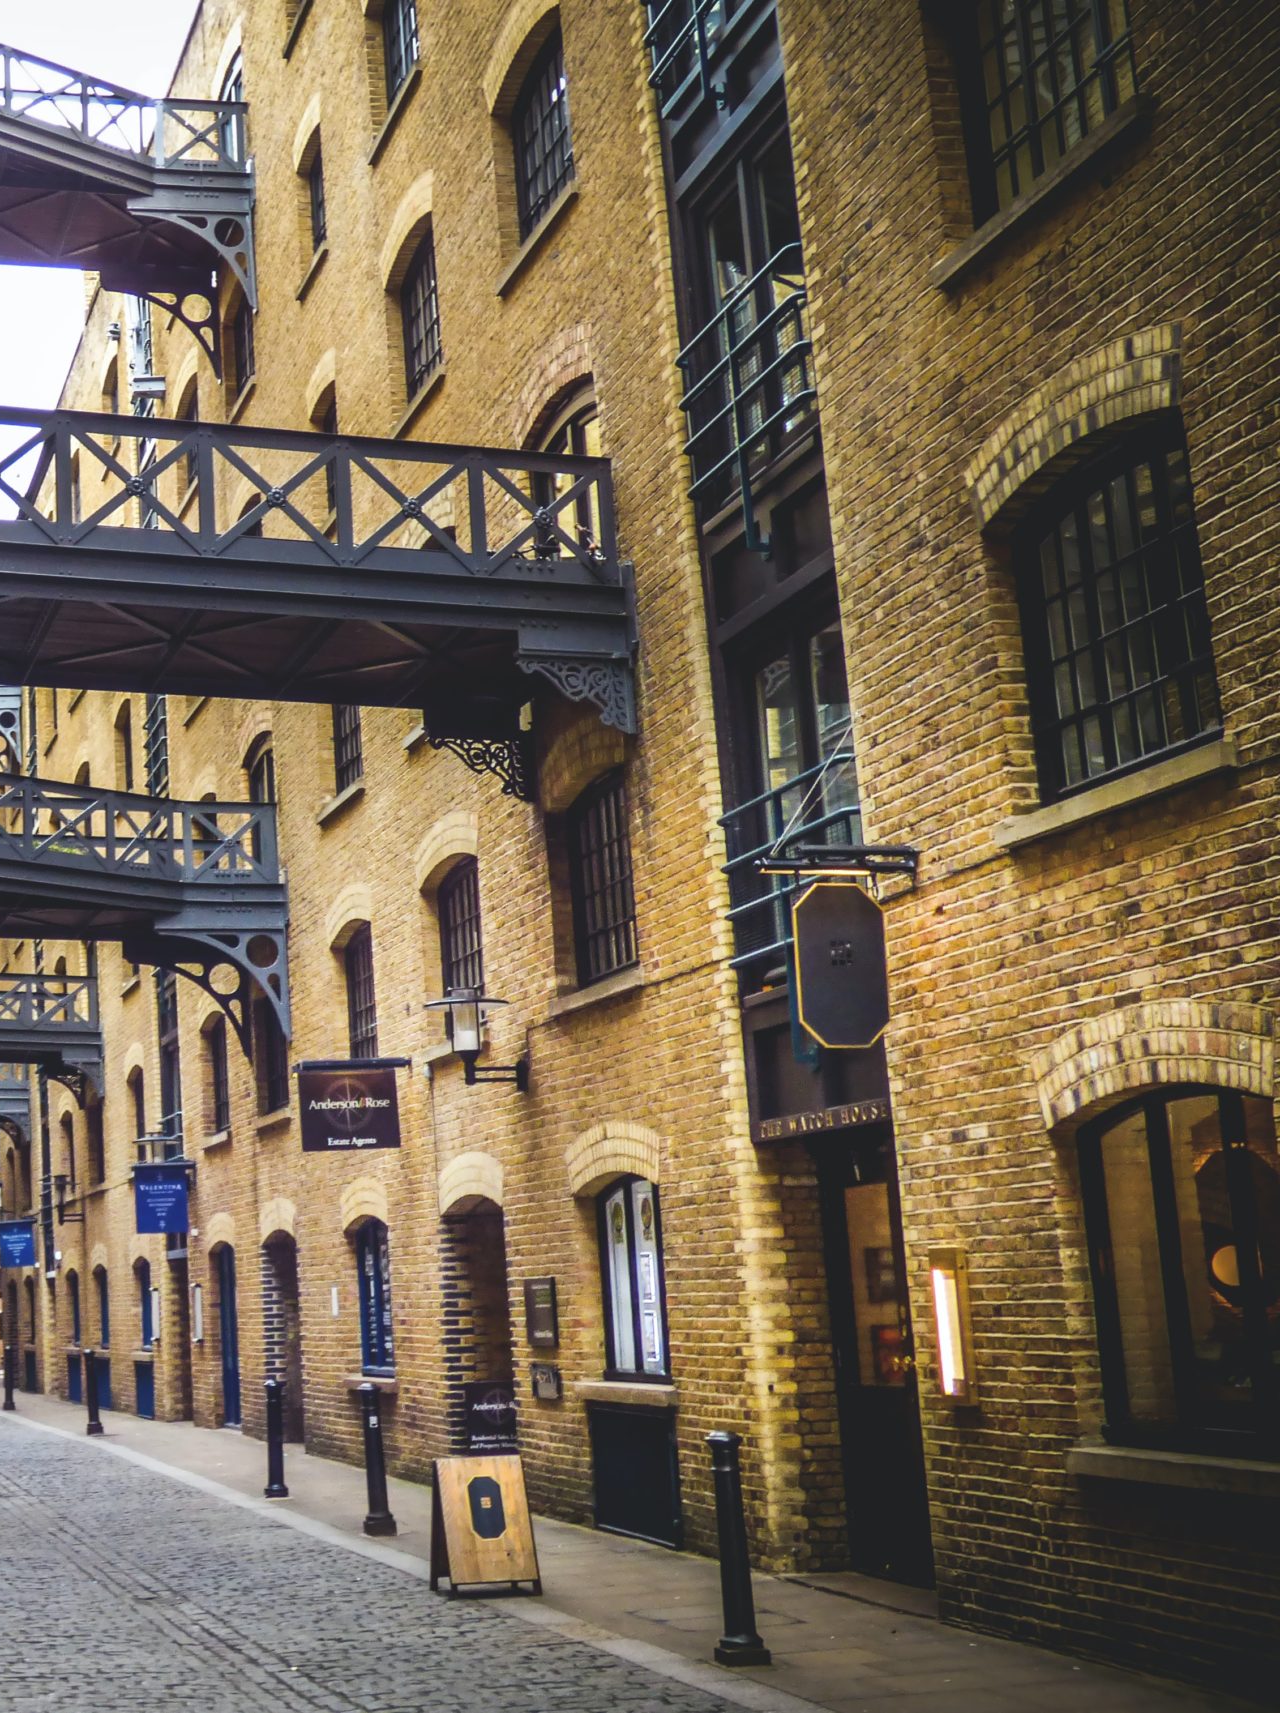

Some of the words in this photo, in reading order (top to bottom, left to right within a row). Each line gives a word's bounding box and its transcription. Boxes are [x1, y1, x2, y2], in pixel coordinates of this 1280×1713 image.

[365, 1096, 391, 1108] Rose
[759, 1120, 782, 1139] THE
[788, 1110, 834, 1133] WATCH
[840, 1102, 889, 1125] HOUSE
[327, 1137, 350, 1146] Estate
[351, 1136, 378, 1148] Agents
